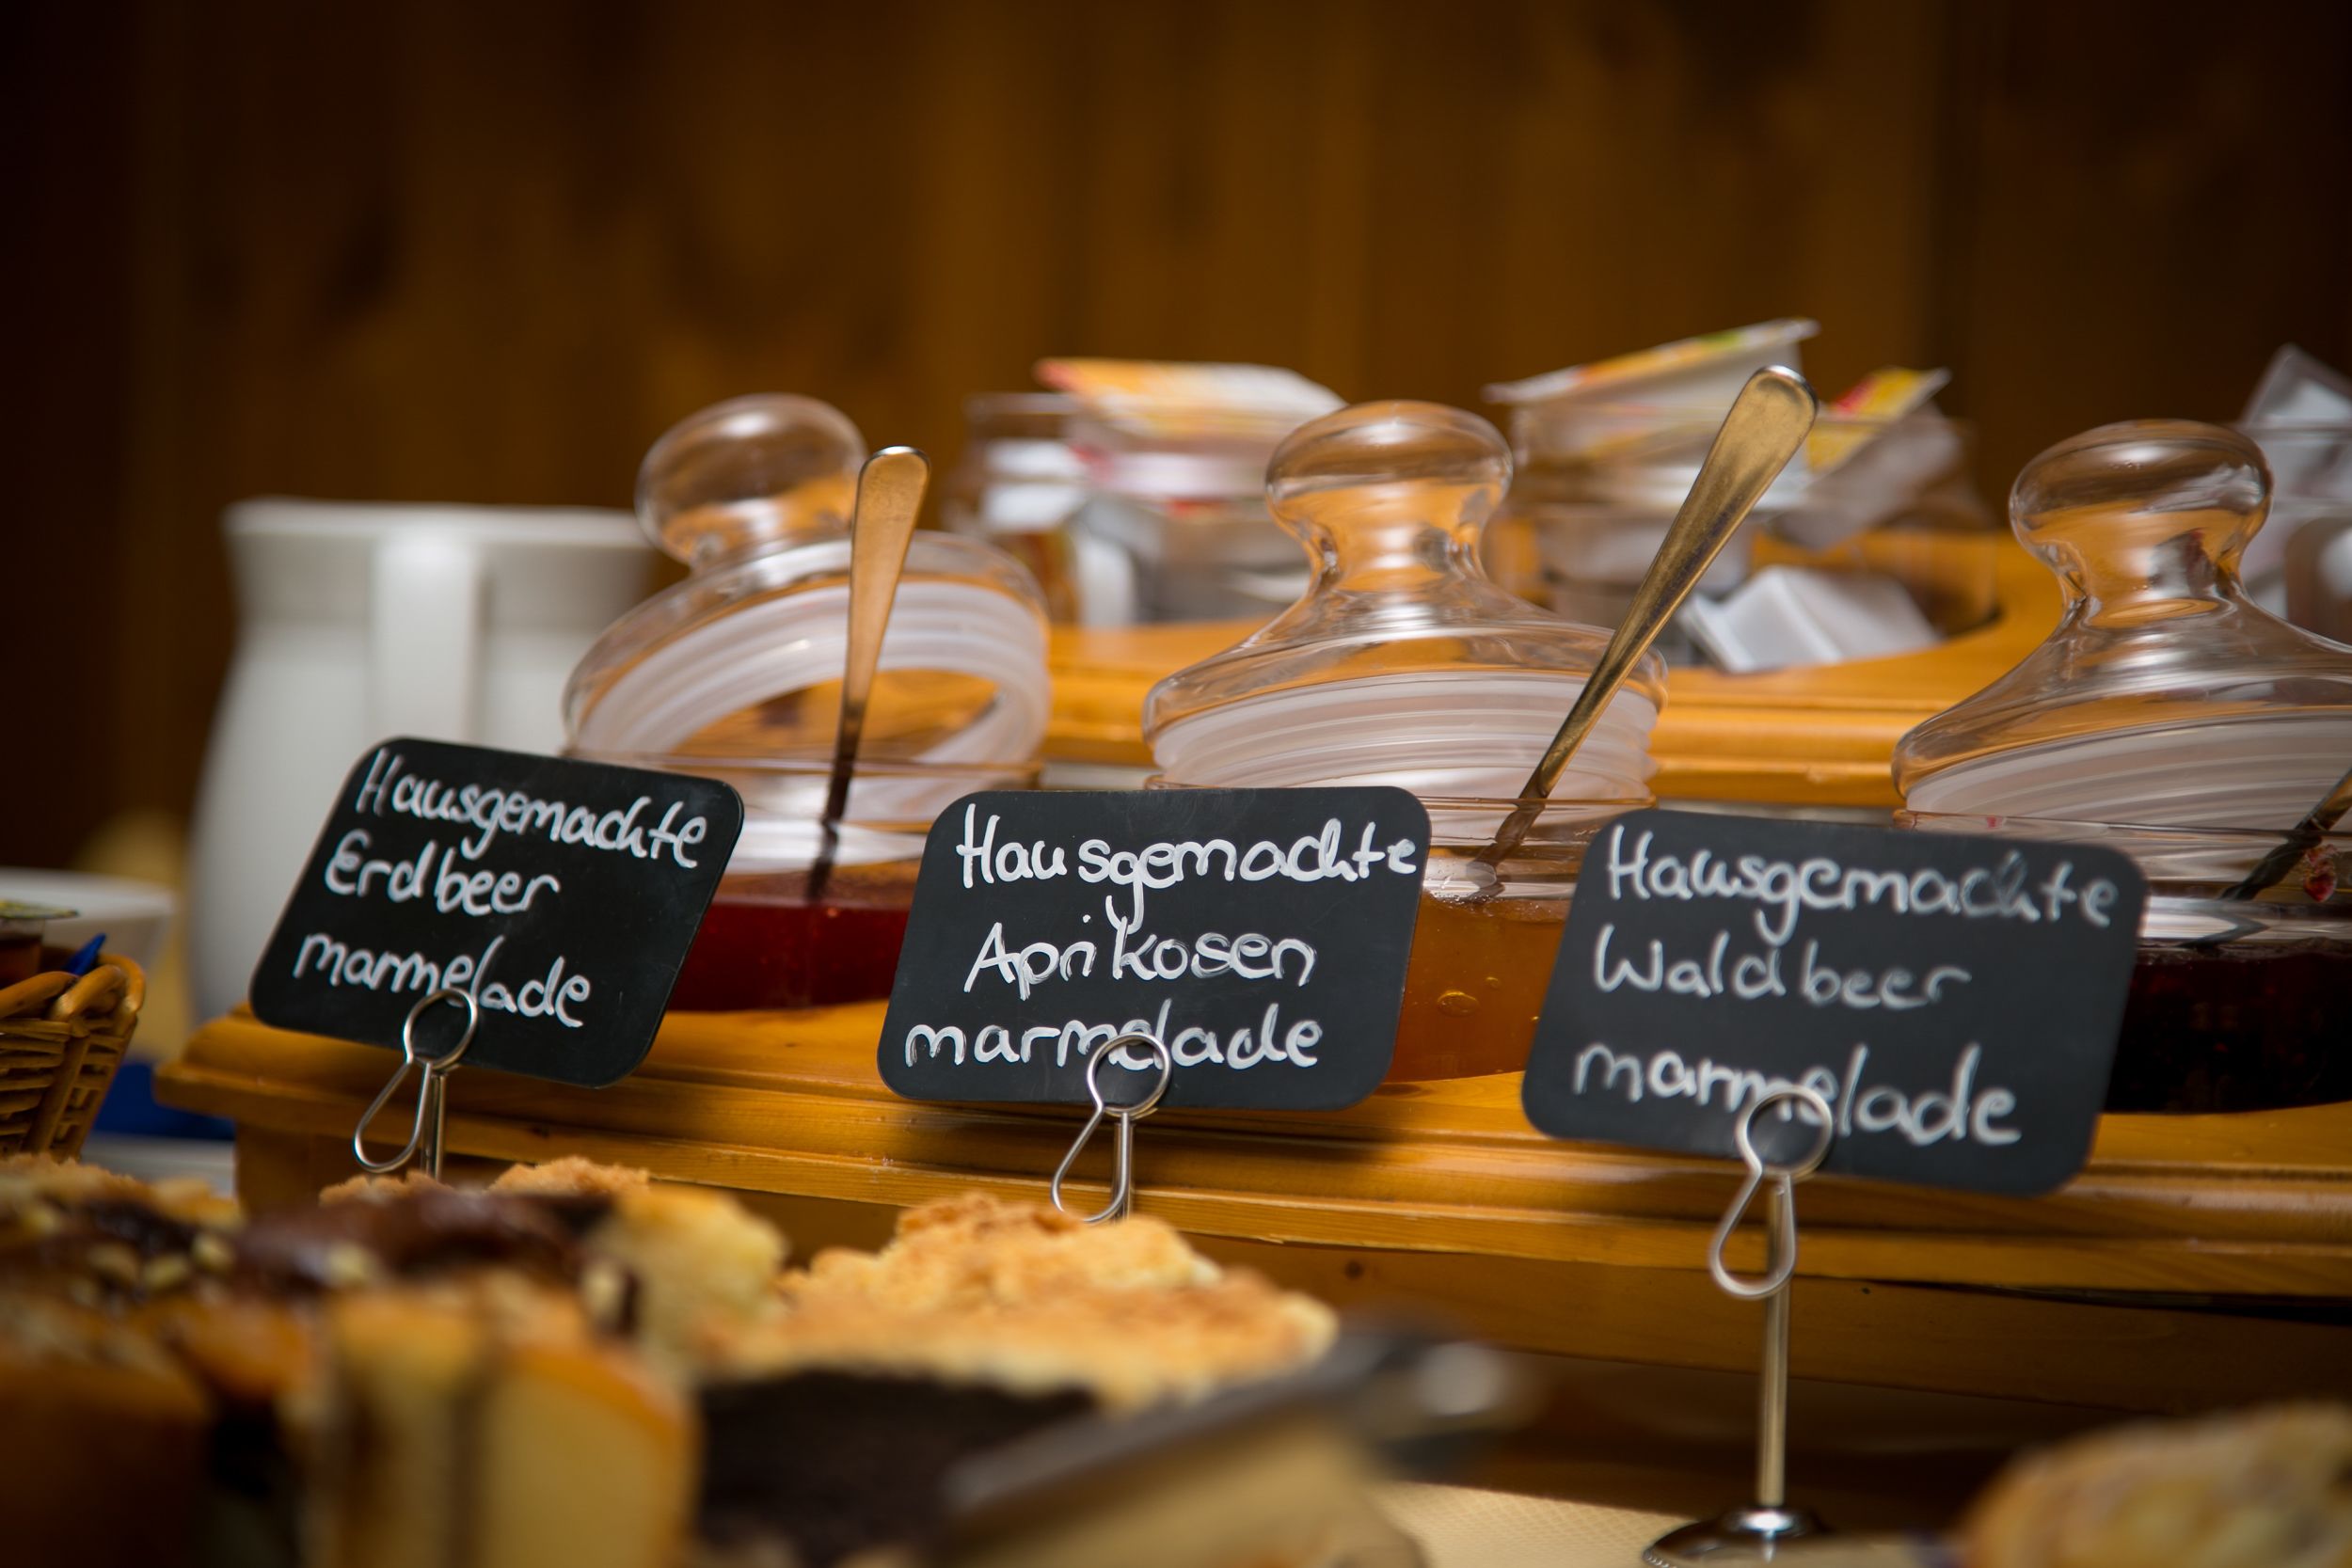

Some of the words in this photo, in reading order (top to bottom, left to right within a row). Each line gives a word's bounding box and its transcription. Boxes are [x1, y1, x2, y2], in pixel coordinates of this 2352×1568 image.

[356, 748, 707, 868] Hausgemachte
[325, 828, 561, 916] Erdbeer
[1606, 824, 2120, 944] Hausgemachte
[292, 933, 592, 1028] marmelade
[904, 999, 1323, 1071] marmelade
[1573, 1041, 2022, 1146] marmelade
